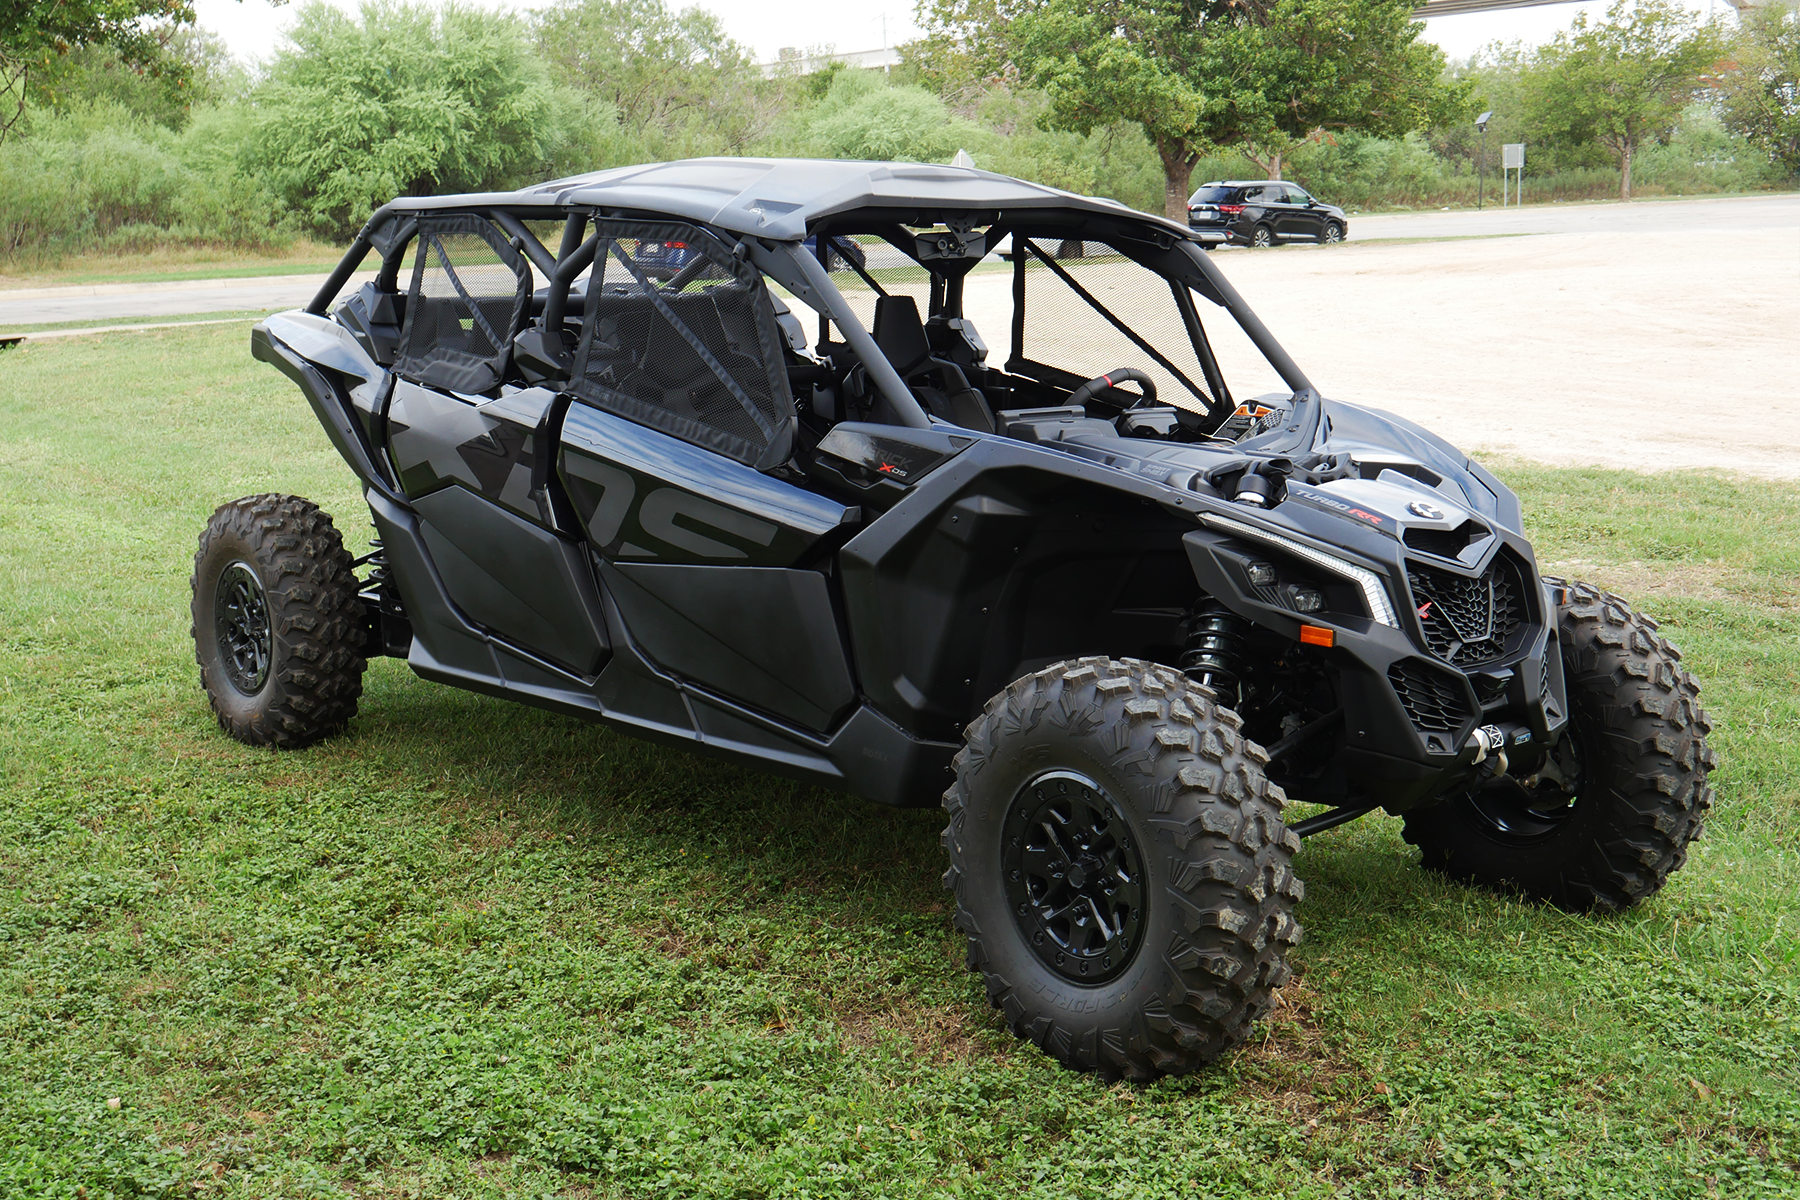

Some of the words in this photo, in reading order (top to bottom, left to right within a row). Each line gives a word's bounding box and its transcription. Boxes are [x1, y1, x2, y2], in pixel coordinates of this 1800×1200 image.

[1296, 489, 1351, 511] TURBO
[1348, 508, 1383, 525] RR
[863, 746, 890, 762] ROTAX
[1026, 977, 1100, 1014] FORCE
